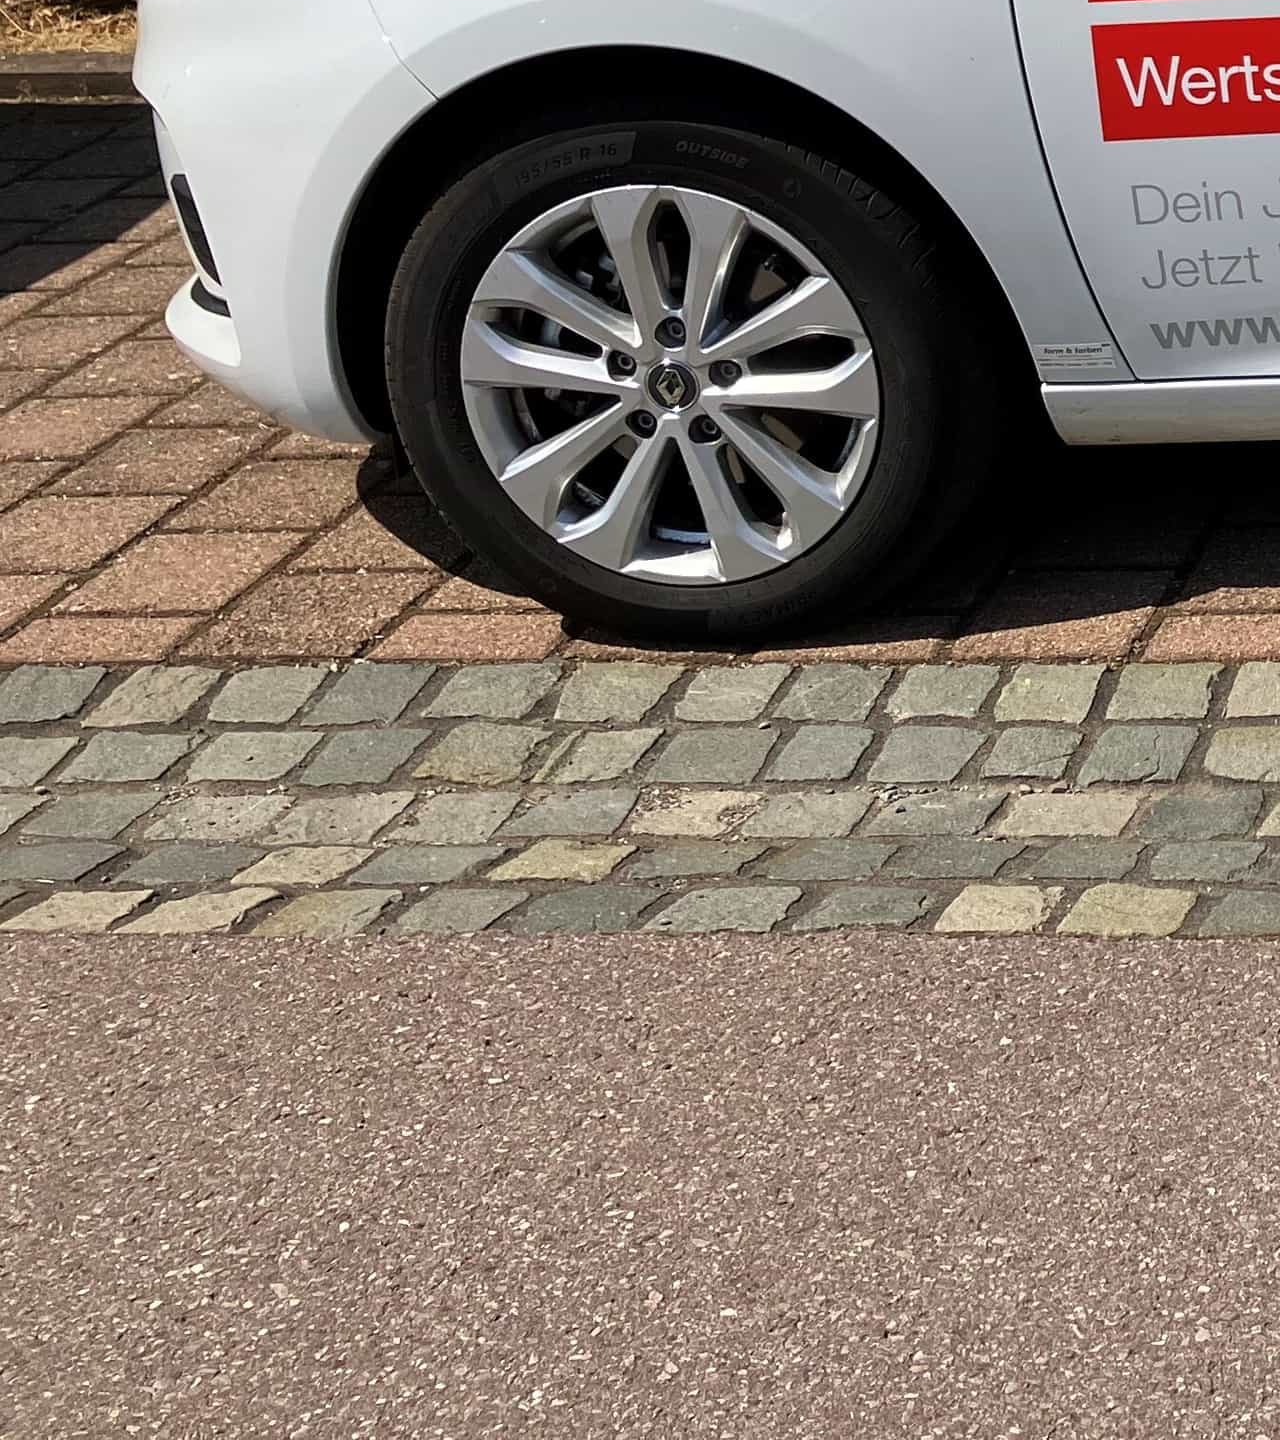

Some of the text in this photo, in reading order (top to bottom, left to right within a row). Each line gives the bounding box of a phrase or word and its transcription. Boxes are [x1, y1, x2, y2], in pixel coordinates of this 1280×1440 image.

[674, 139, 750, 168] OUTSIDE
[1131, 181, 1244, 226] Dein
[1141, 247, 1263, 291] Jetzt
